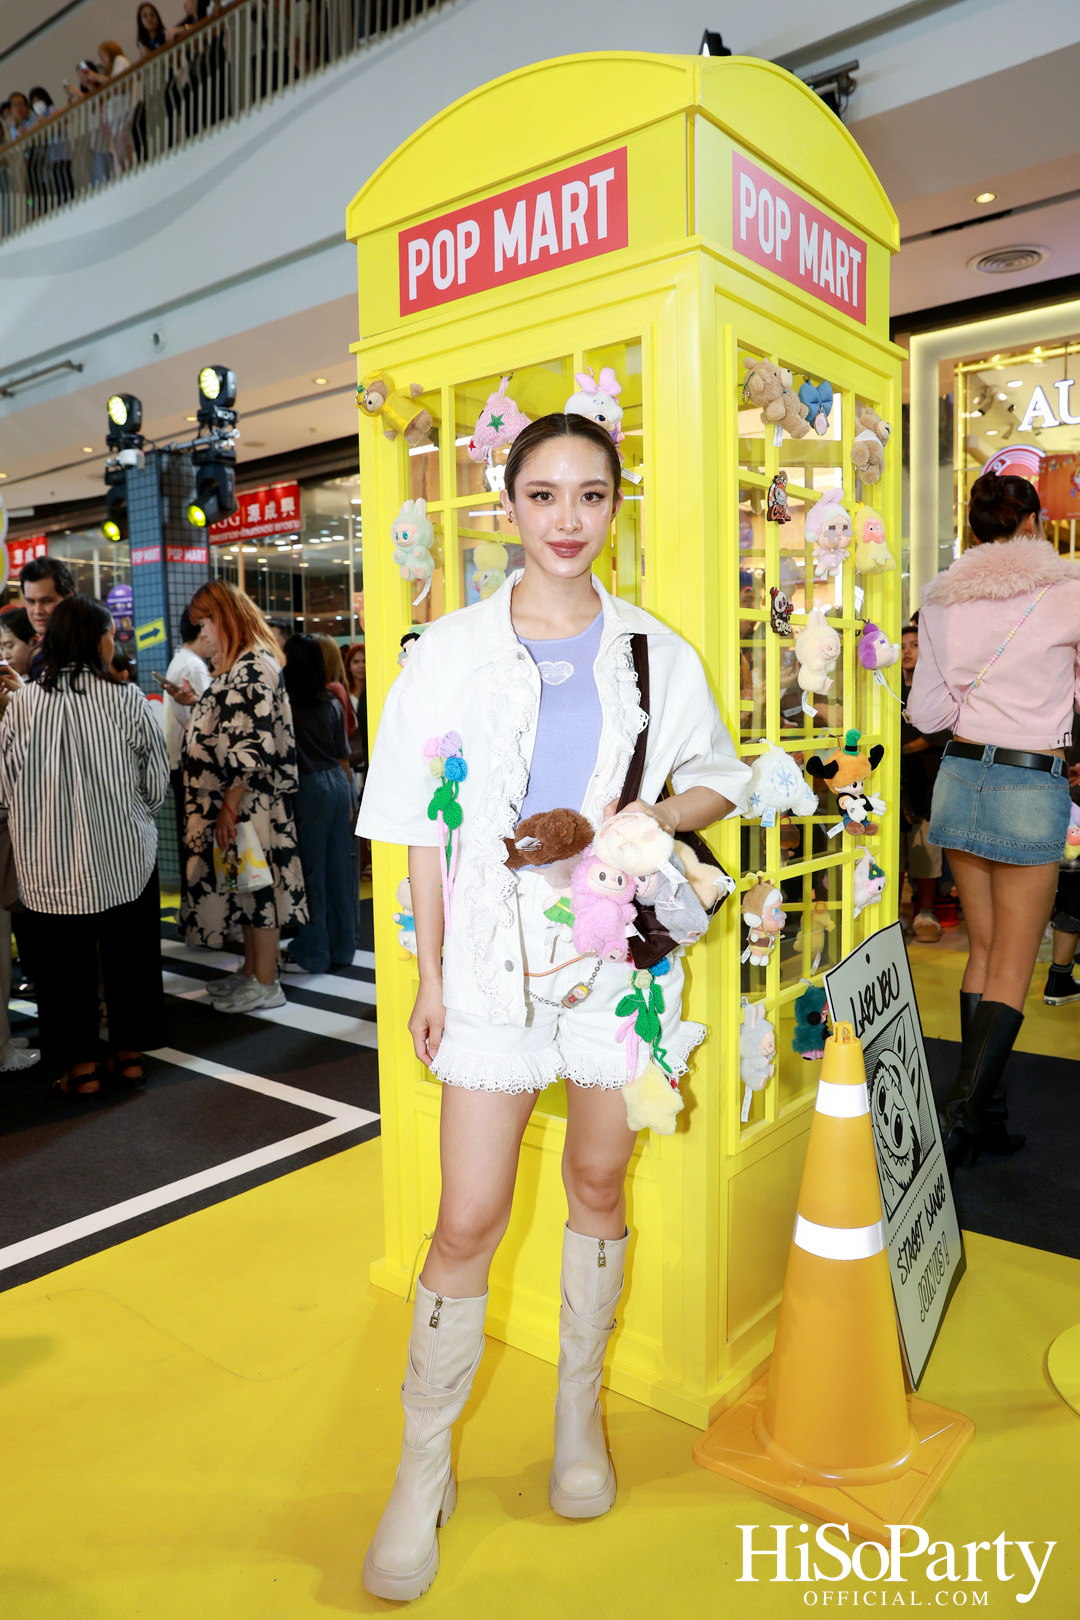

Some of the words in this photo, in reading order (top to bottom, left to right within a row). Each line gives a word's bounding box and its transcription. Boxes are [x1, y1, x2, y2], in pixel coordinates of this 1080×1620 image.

[408, 219, 480, 300] POP
[494, 167, 614, 273] MART
[739, 172, 791, 262] POP
[799, 212, 862, 308] MART
[167, 547, 184, 560] POP
[184, 549, 207, 562] MART
[850, 962, 900, 1038] LABUBU
[897, 1211, 925, 1285] STREET
[918, 1259, 936, 1322] JOIN
